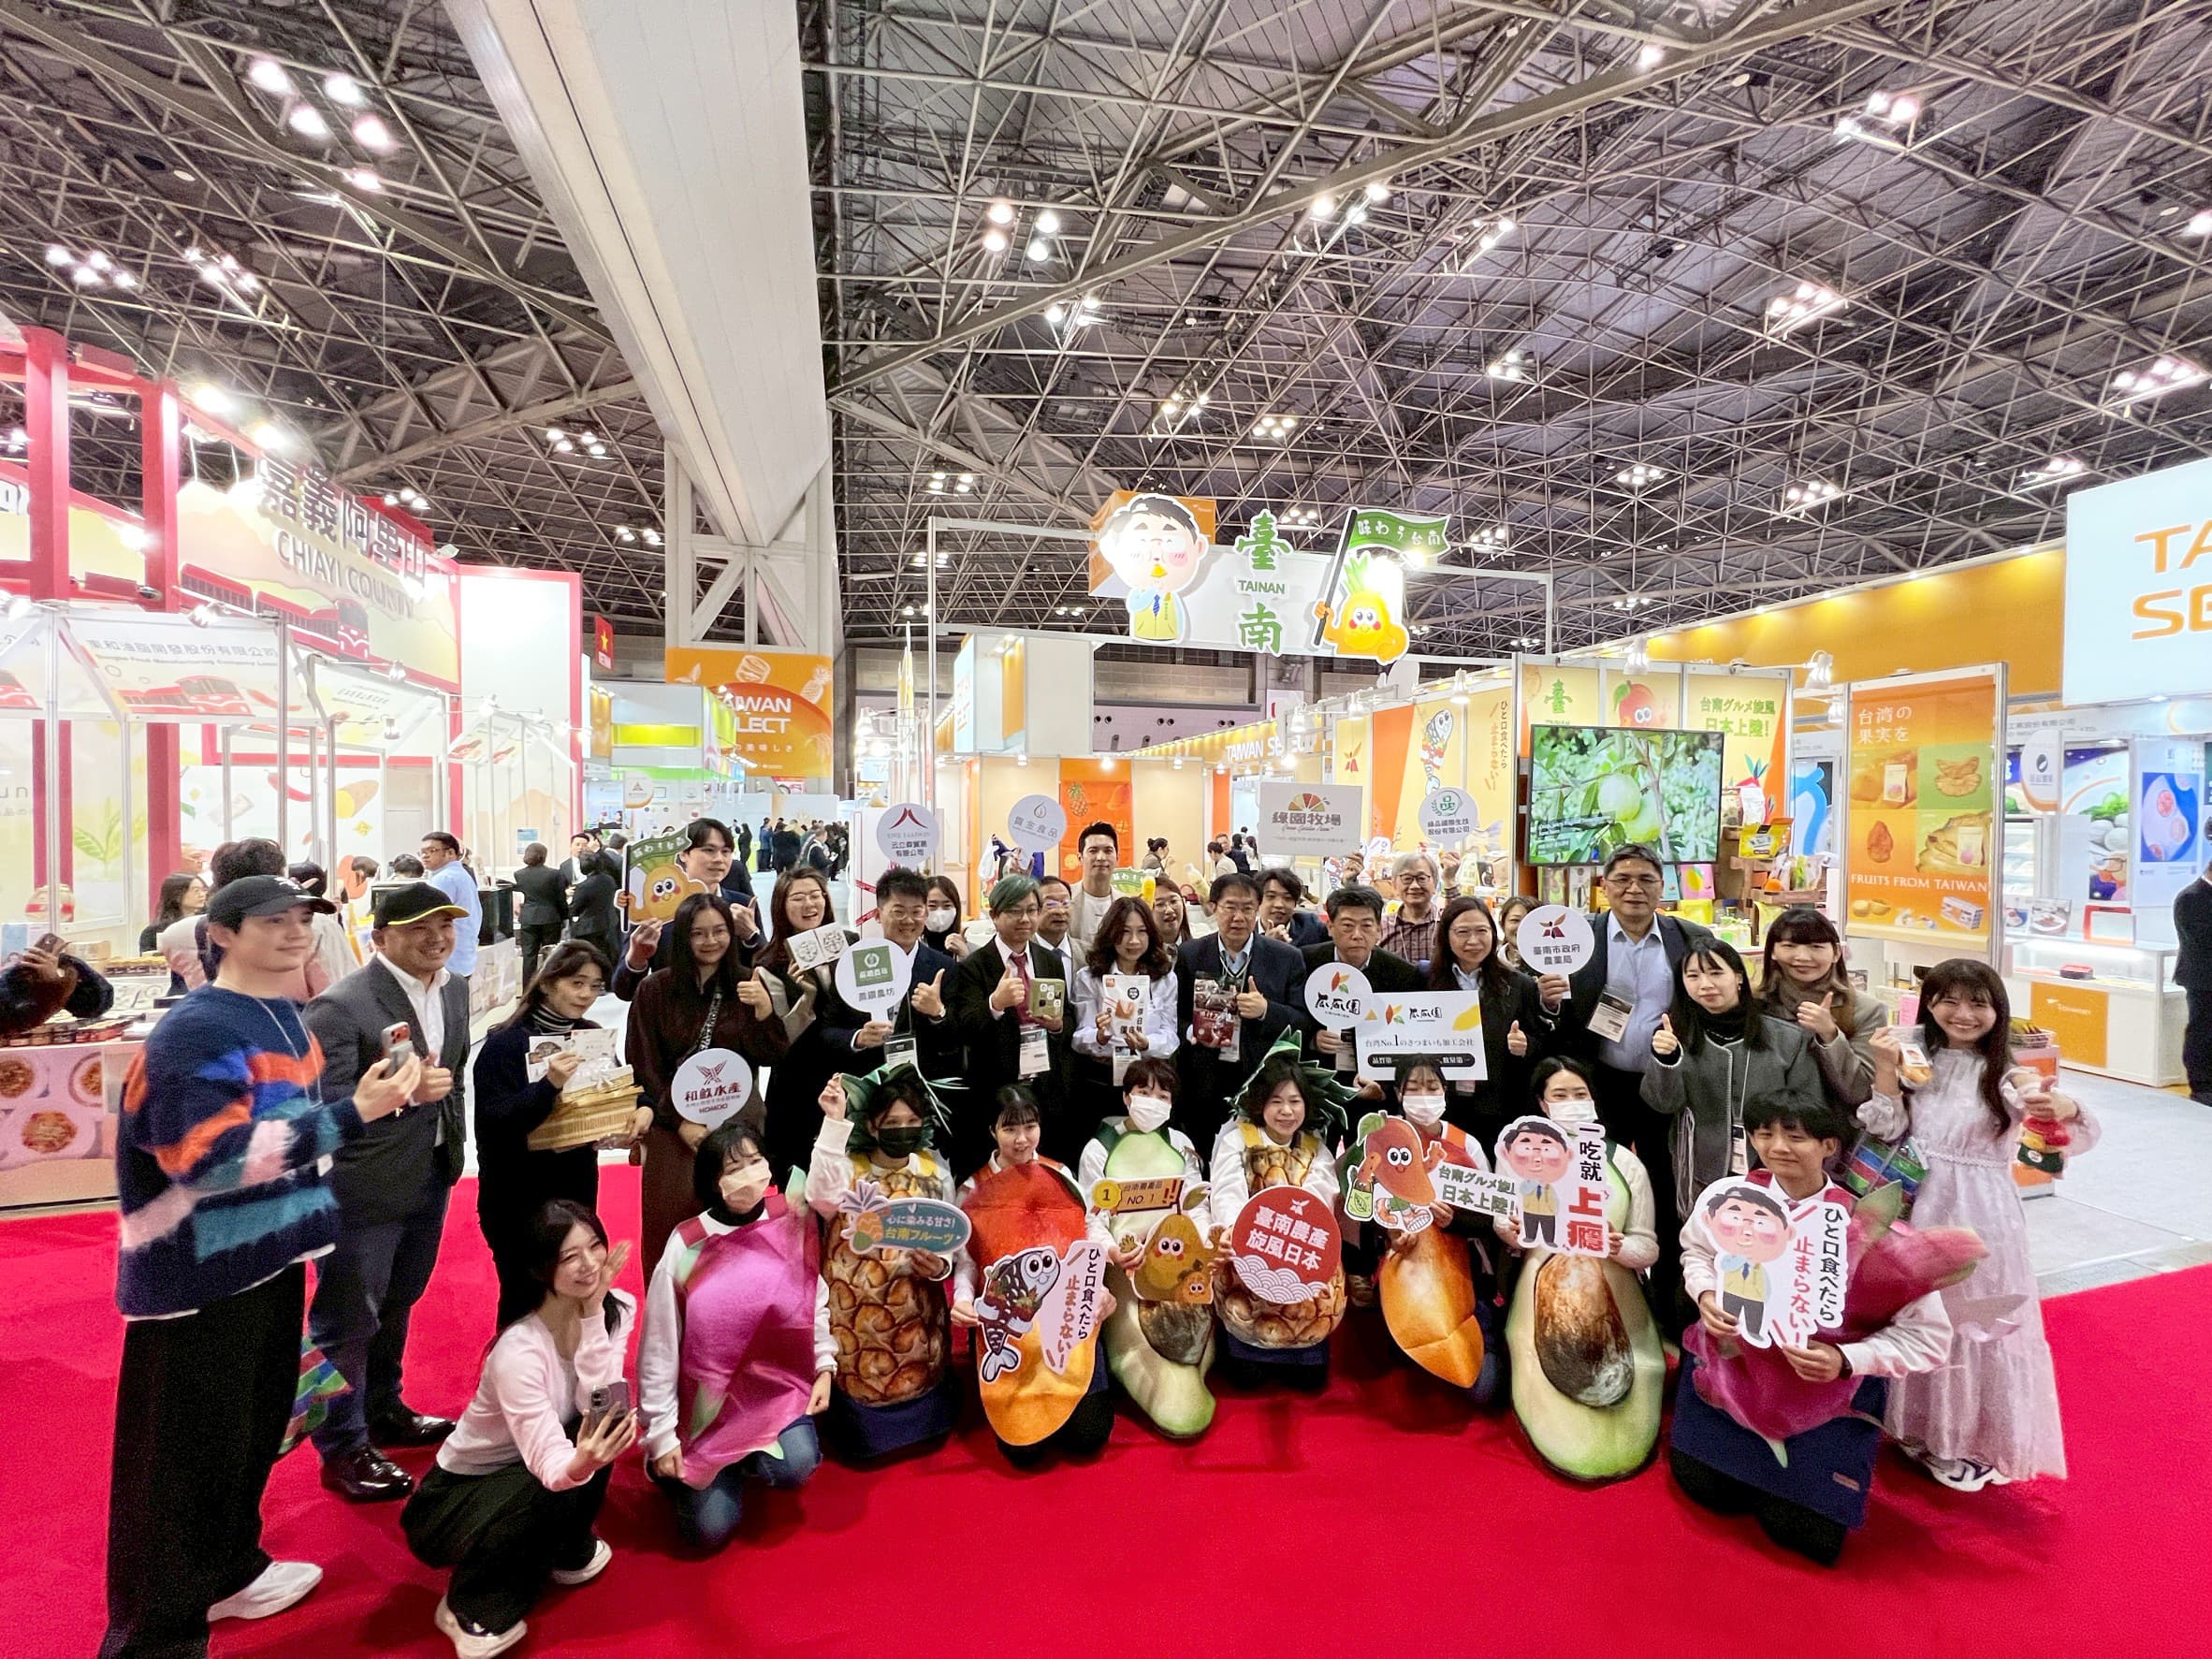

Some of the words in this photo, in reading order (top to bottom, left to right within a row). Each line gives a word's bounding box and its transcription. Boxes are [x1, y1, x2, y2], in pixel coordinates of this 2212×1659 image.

[1233, 512, 1293, 570] 臺
[1358, 518, 1441, 546] 味わう台南
[276, 530, 342, 589] CHIAYI
[345, 566, 415, 620] COUNTY
[1238, 579, 1286, 595] TAINAN
[1238, 602, 1283, 655] 南
[1700, 696, 1775, 715] 台南グルメ旋風
[1858, 706, 1913, 726] 台湾の
[1500, 700, 1508, 769] ひと口食べたら
[1856, 726, 1910, 746] 果実を
[1226, 739, 1264, 763] TAIWAN
[1273, 811, 1342, 826] 綠園牧場
[1851, 873, 1890, 885] FRUITS
[1893, 876, 1930, 888] FROM
[1934, 879, 1987, 892] TAIWAN
[1534, 943, 1580, 955] 臺南市政府
[1102, 1188, 1111, 1201] 1
[884, 1226, 954, 1245] 台南フルーツ
[1254, 1204, 1330, 1251] 臺南農產
[1245, 1228, 1322, 1271] 旋風日本
[1818, 1207, 1842, 1321] ひと口食べたら
[1077, 1247, 1101, 1340] ひと口食べたら
[1788, 1235, 1815, 1347] 止まらない!
[1057, 1273, 1081, 1369] 止まらない!
